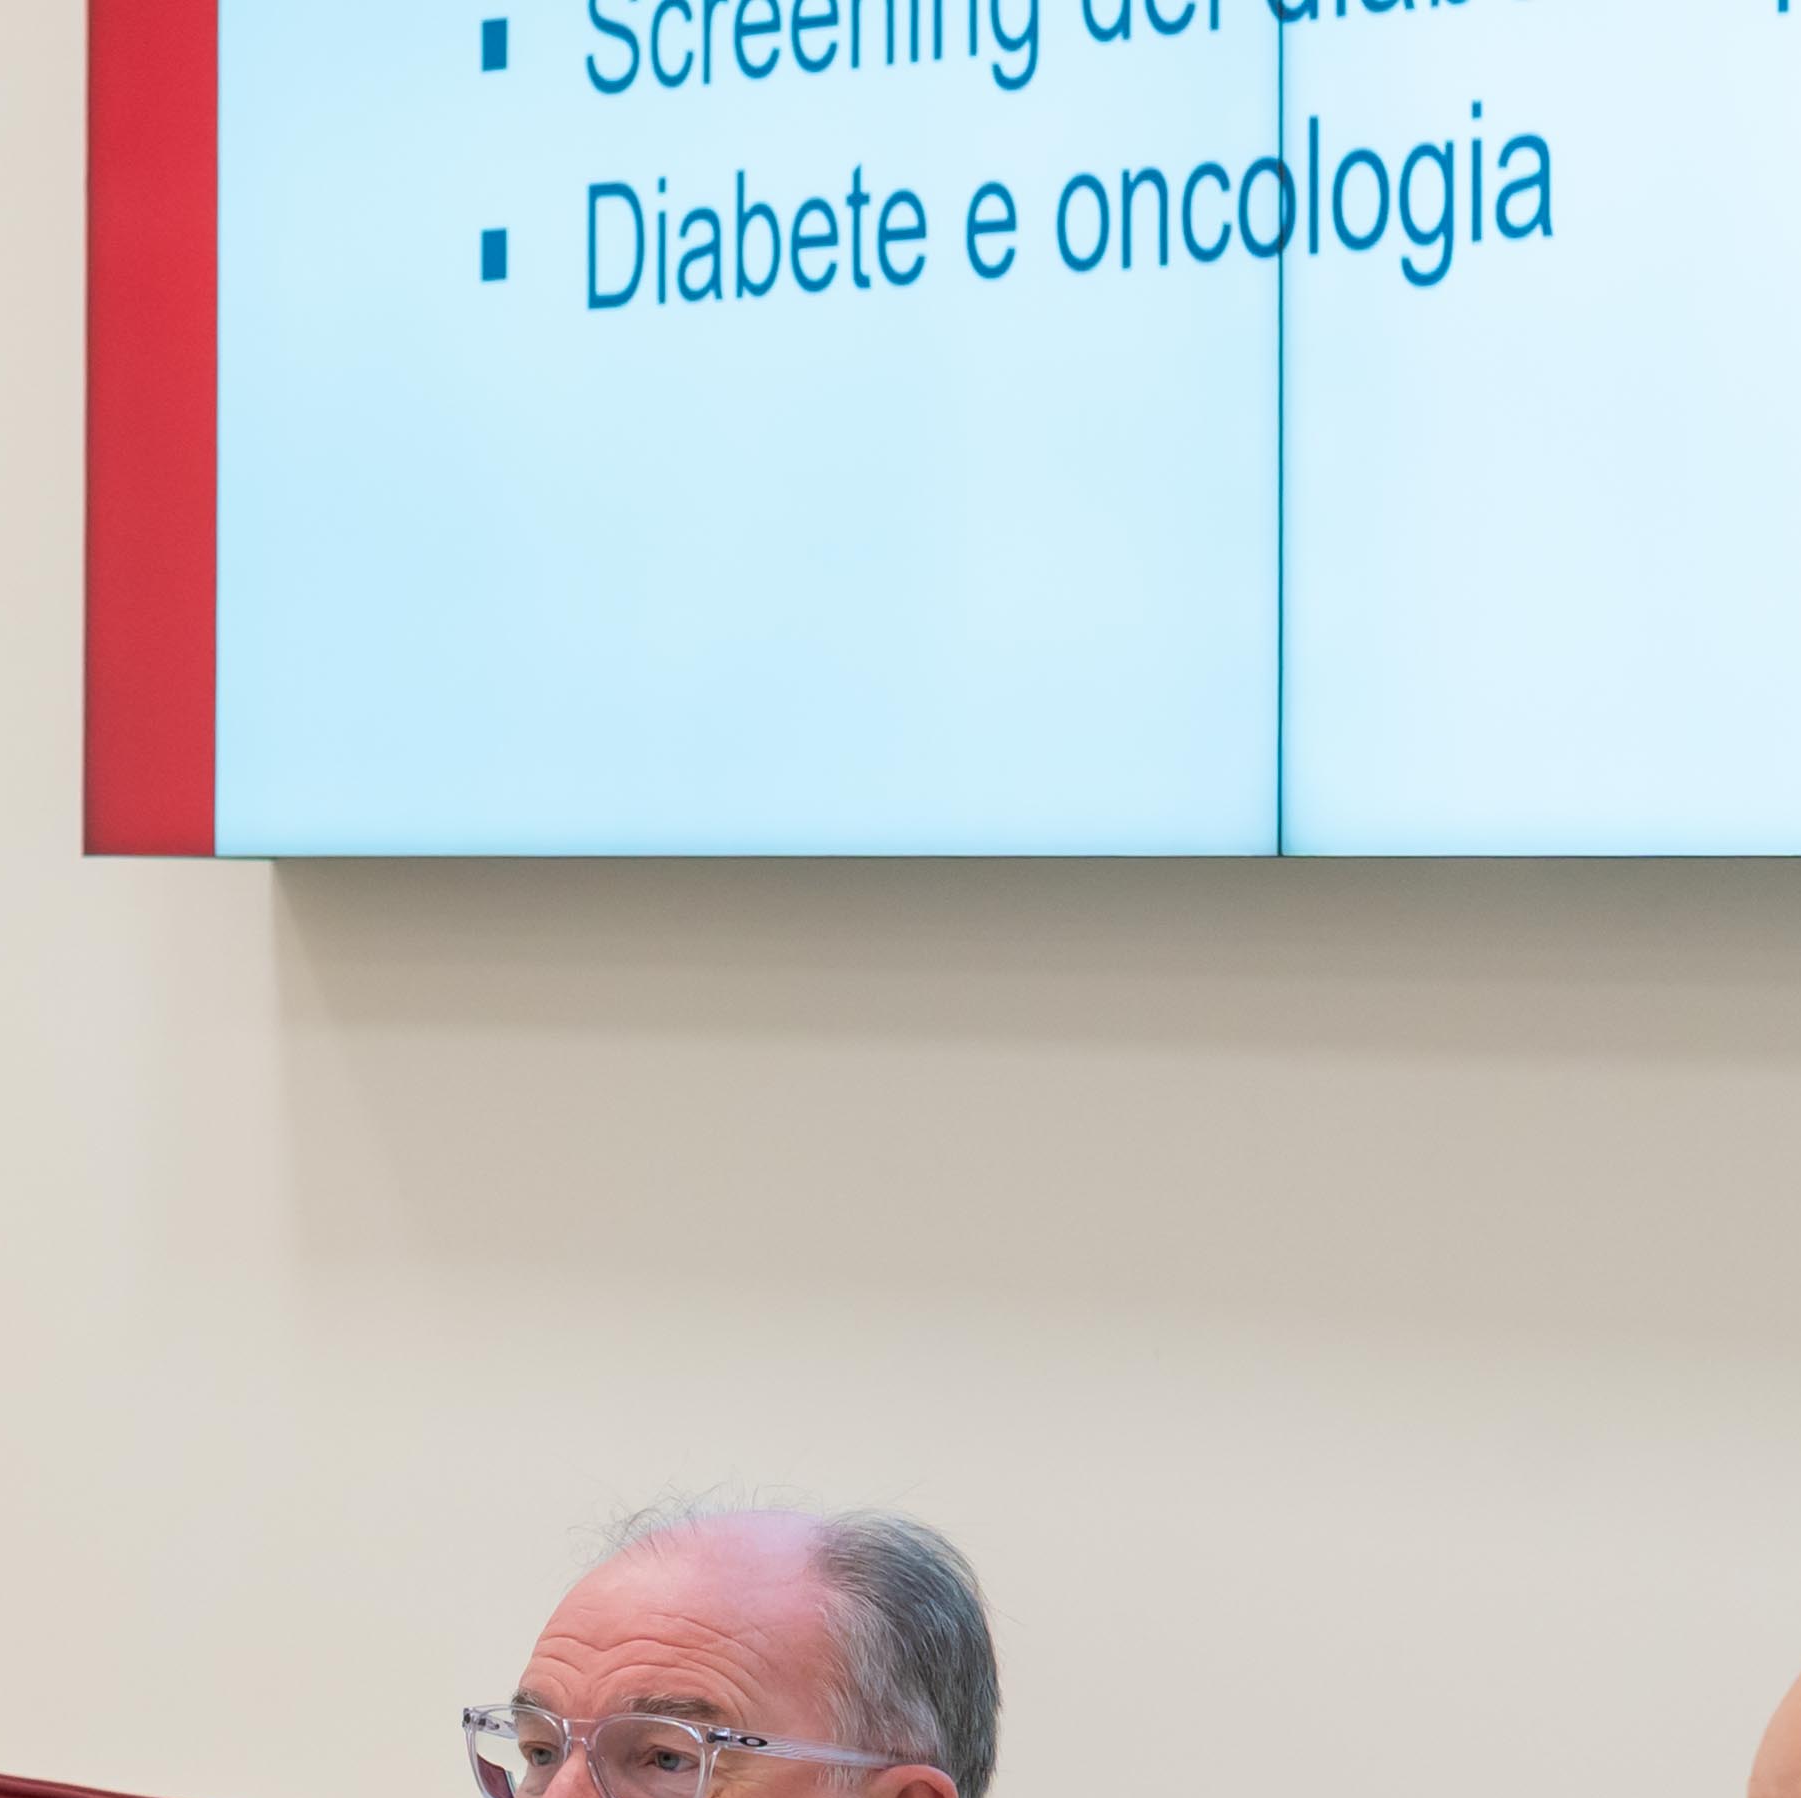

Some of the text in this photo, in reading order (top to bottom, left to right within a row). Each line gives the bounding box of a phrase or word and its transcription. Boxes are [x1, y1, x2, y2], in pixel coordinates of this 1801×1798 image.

[587, 101, 1555, 311] Diabete e oncologia
